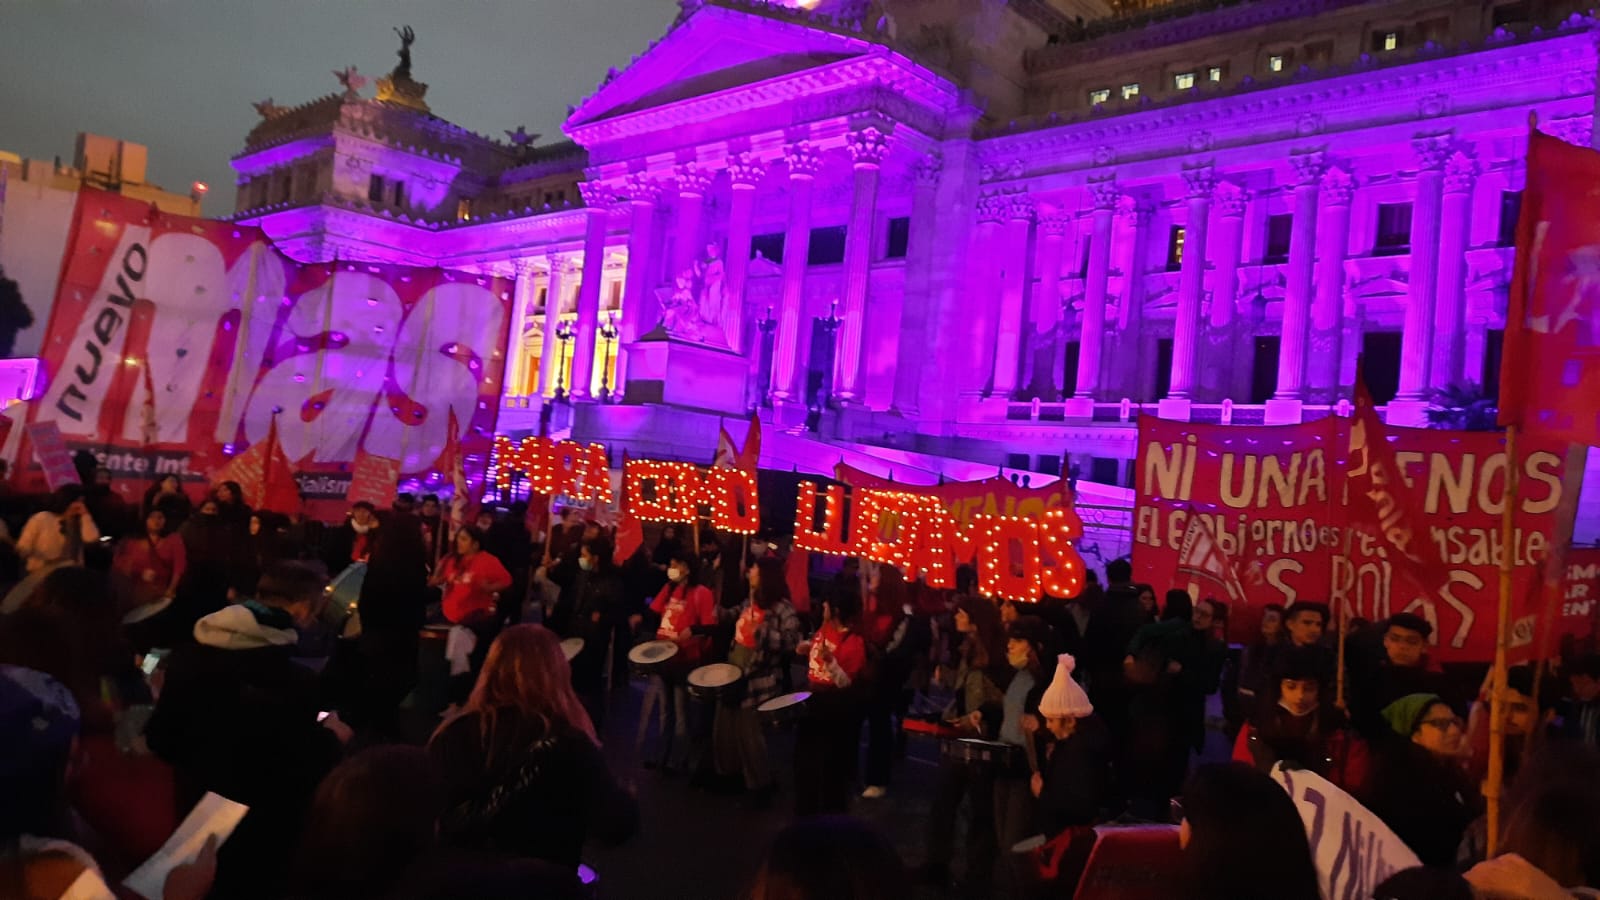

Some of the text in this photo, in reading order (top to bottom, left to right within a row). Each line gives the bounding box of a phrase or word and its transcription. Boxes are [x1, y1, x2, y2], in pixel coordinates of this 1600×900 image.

[56, 242, 149, 422] nuevo
[1219, 449, 1327, 508] UNA
[1343, 451, 1562, 515] ENOS
